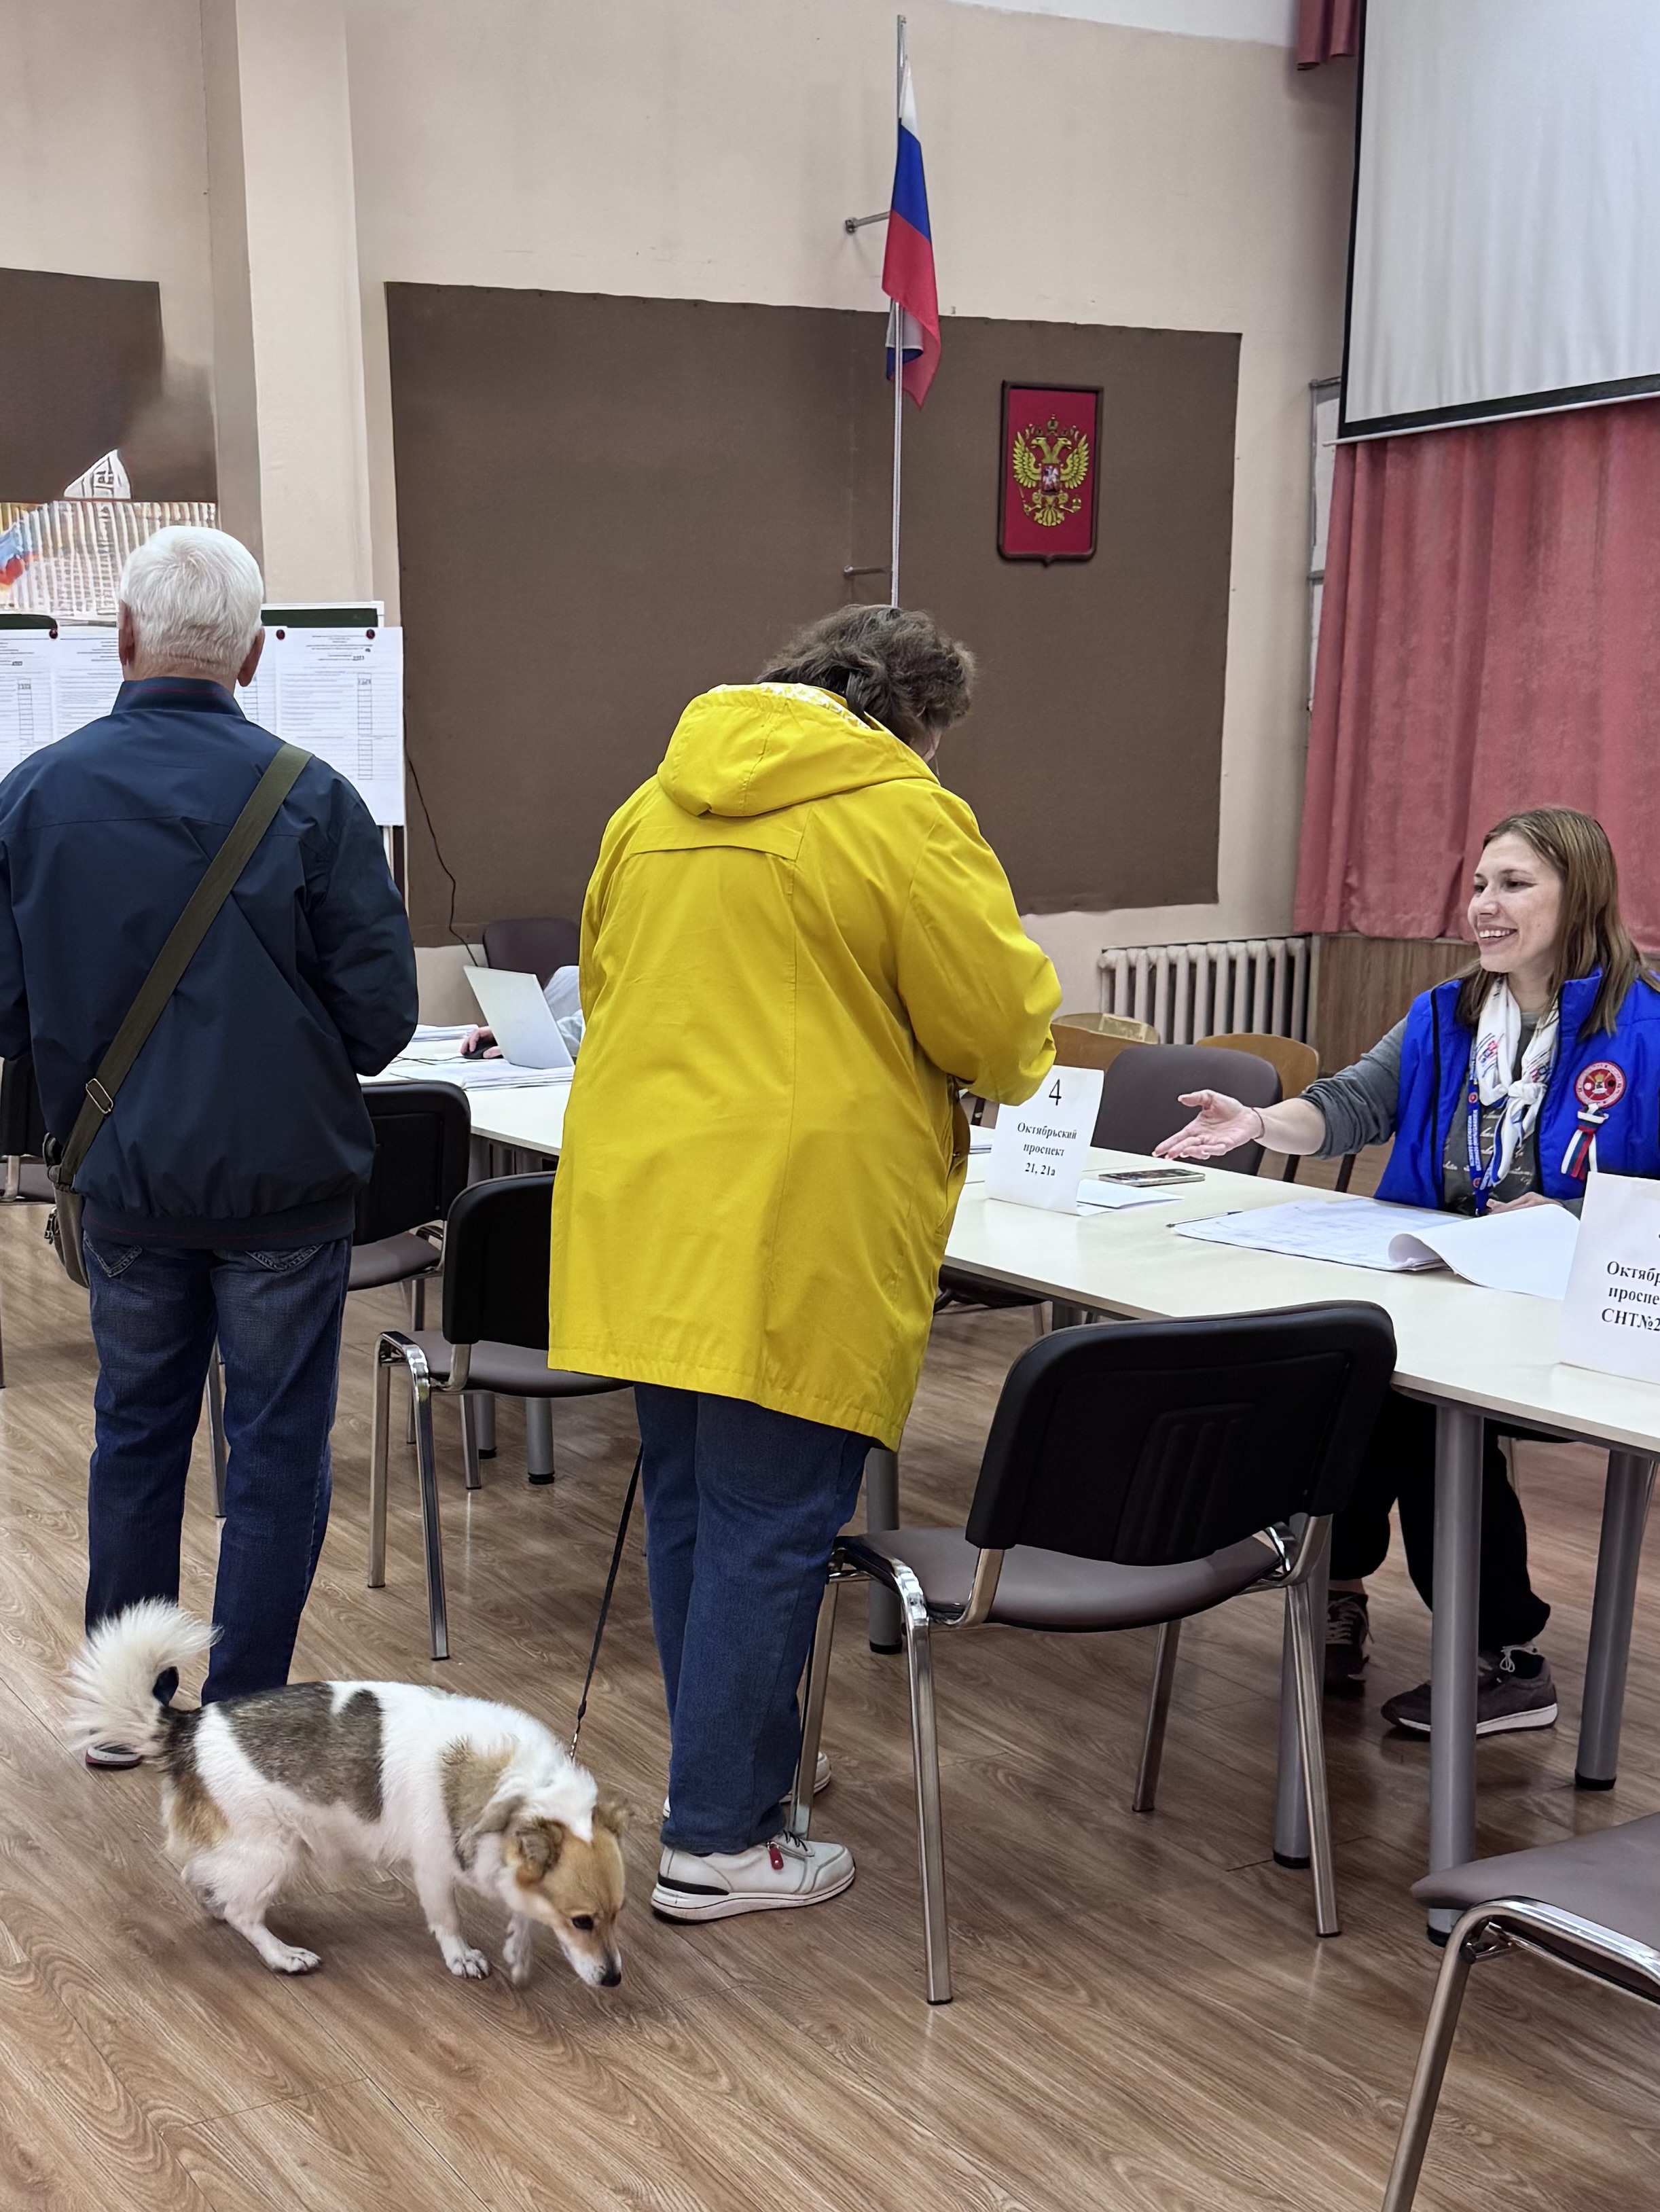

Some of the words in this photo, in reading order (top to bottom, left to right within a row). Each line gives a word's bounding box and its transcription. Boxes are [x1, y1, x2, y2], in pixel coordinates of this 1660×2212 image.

[1048, 1078, 1062, 1106] 4
[1017, 1122, 1078, 1140] Октябрьский
[1023, 1143, 1065, 1157] проспект
[1024, 1162, 1038, 1176] 21,
